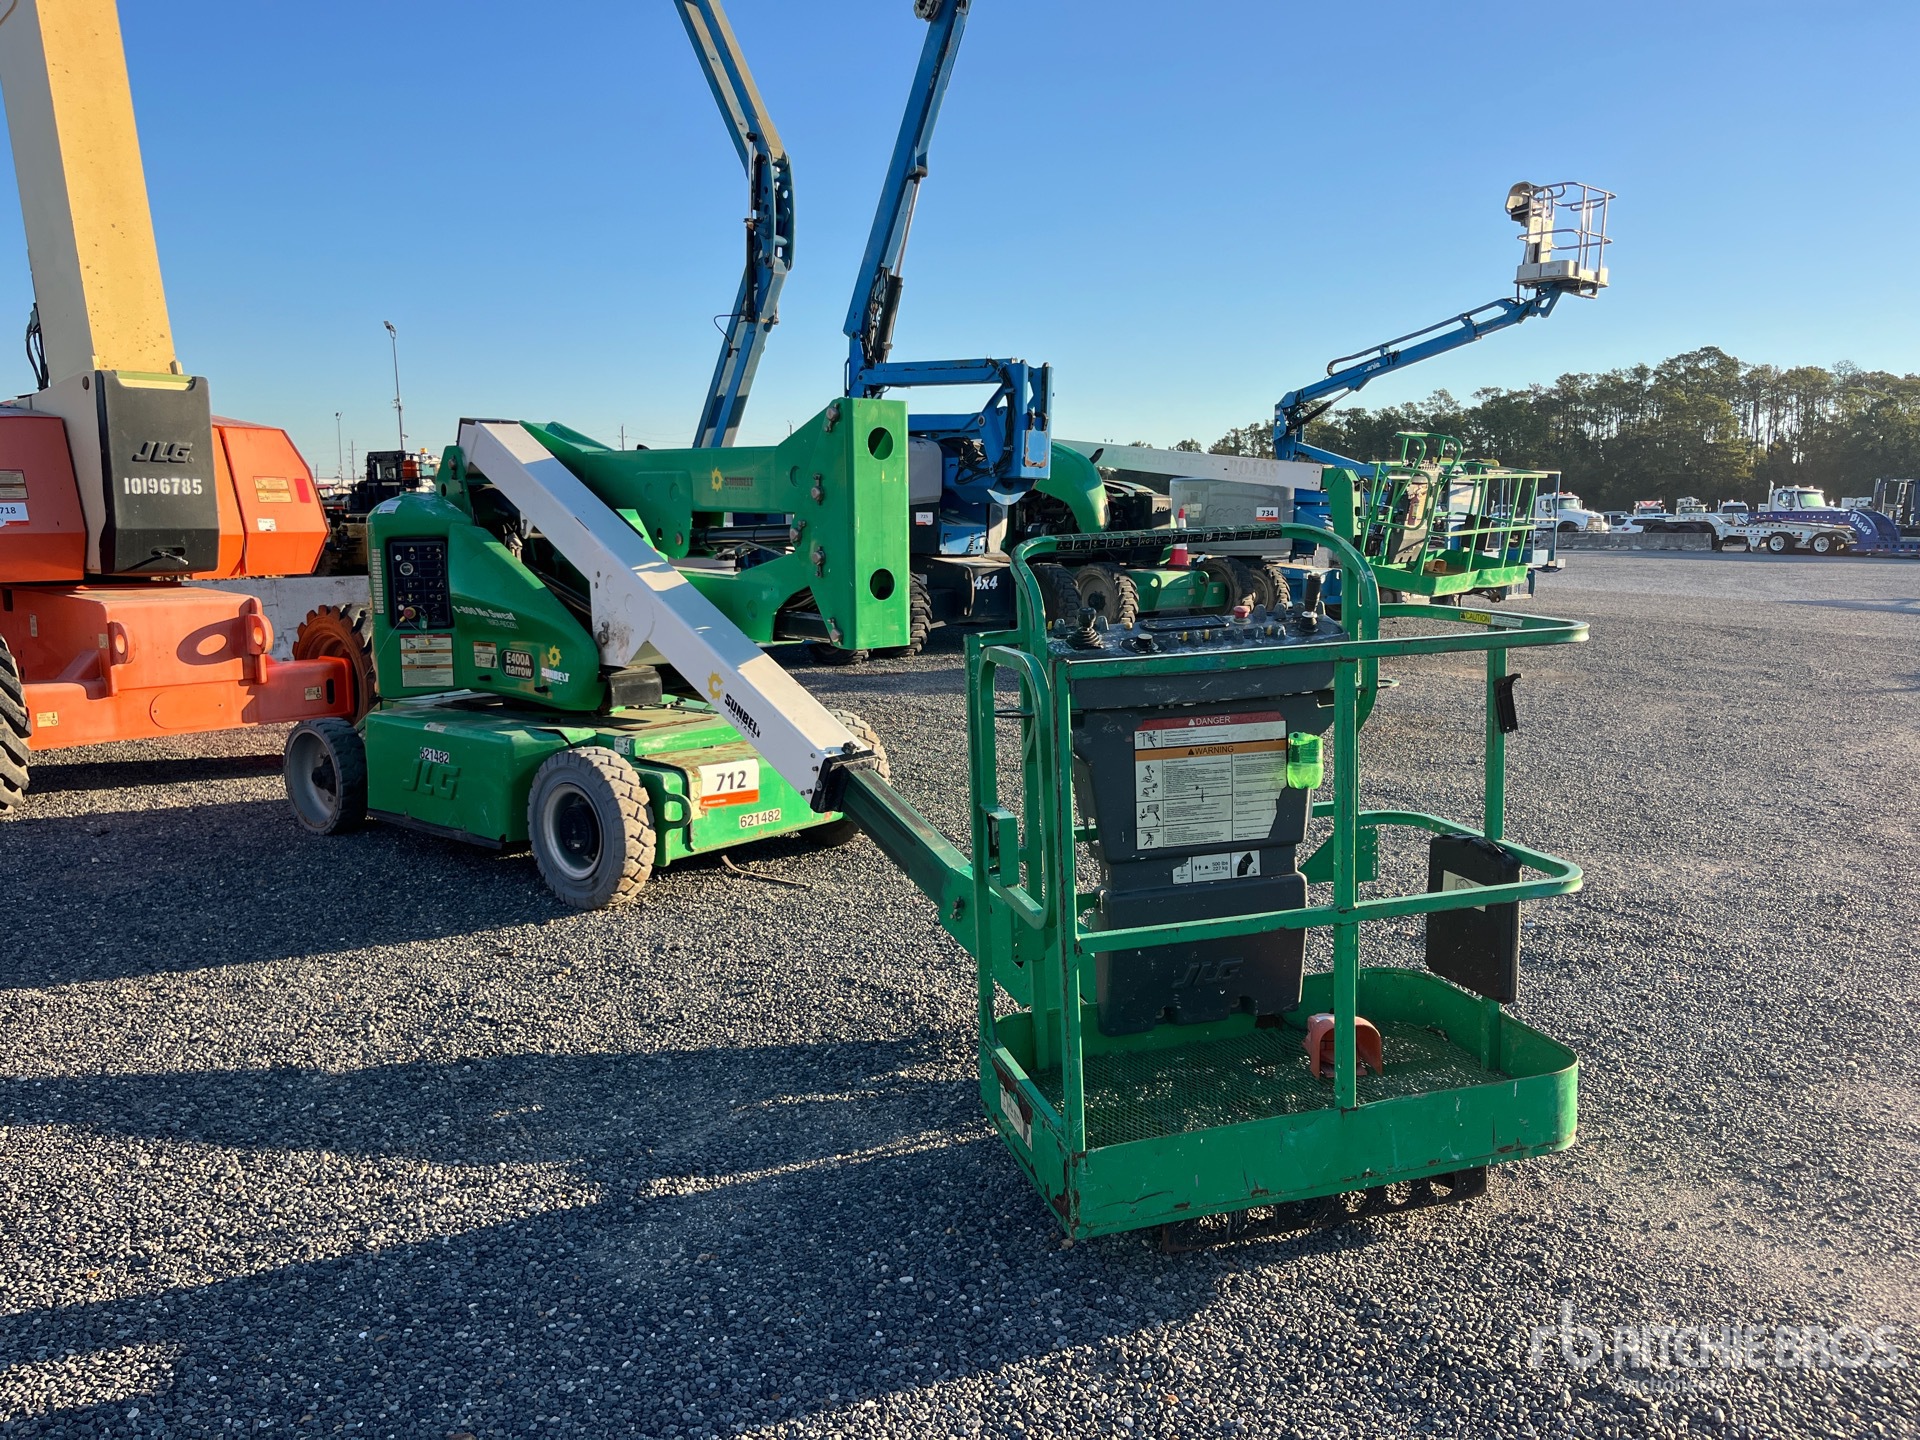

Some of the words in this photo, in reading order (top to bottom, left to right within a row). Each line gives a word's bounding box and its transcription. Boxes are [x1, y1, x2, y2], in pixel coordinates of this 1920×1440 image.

[131, 440, 194, 463] JLG
[1228, 459, 1280, 478] ROJAS
[124, 477, 203, 495] 10196785
[0, 506, 17, 515] 718
[1261, 509, 1274, 517] 734
[974, 575, 998, 590] 4x4
[487, 609, 517, 621] Sweat
[1465, 610, 1490, 623] CAUTION
[506, 651, 531, 667] E400A
[505, 665, 532, 677] narrow
[1195, 716, 1231, 726] DANGER
[420, 747, 449, 765] 621482
[1194, 745, 1234, 755] WARNING
[402, 758, 462, 800] JLG
[716, 770, 747, 791] 712
[740, 809, 781, 828] 621482
